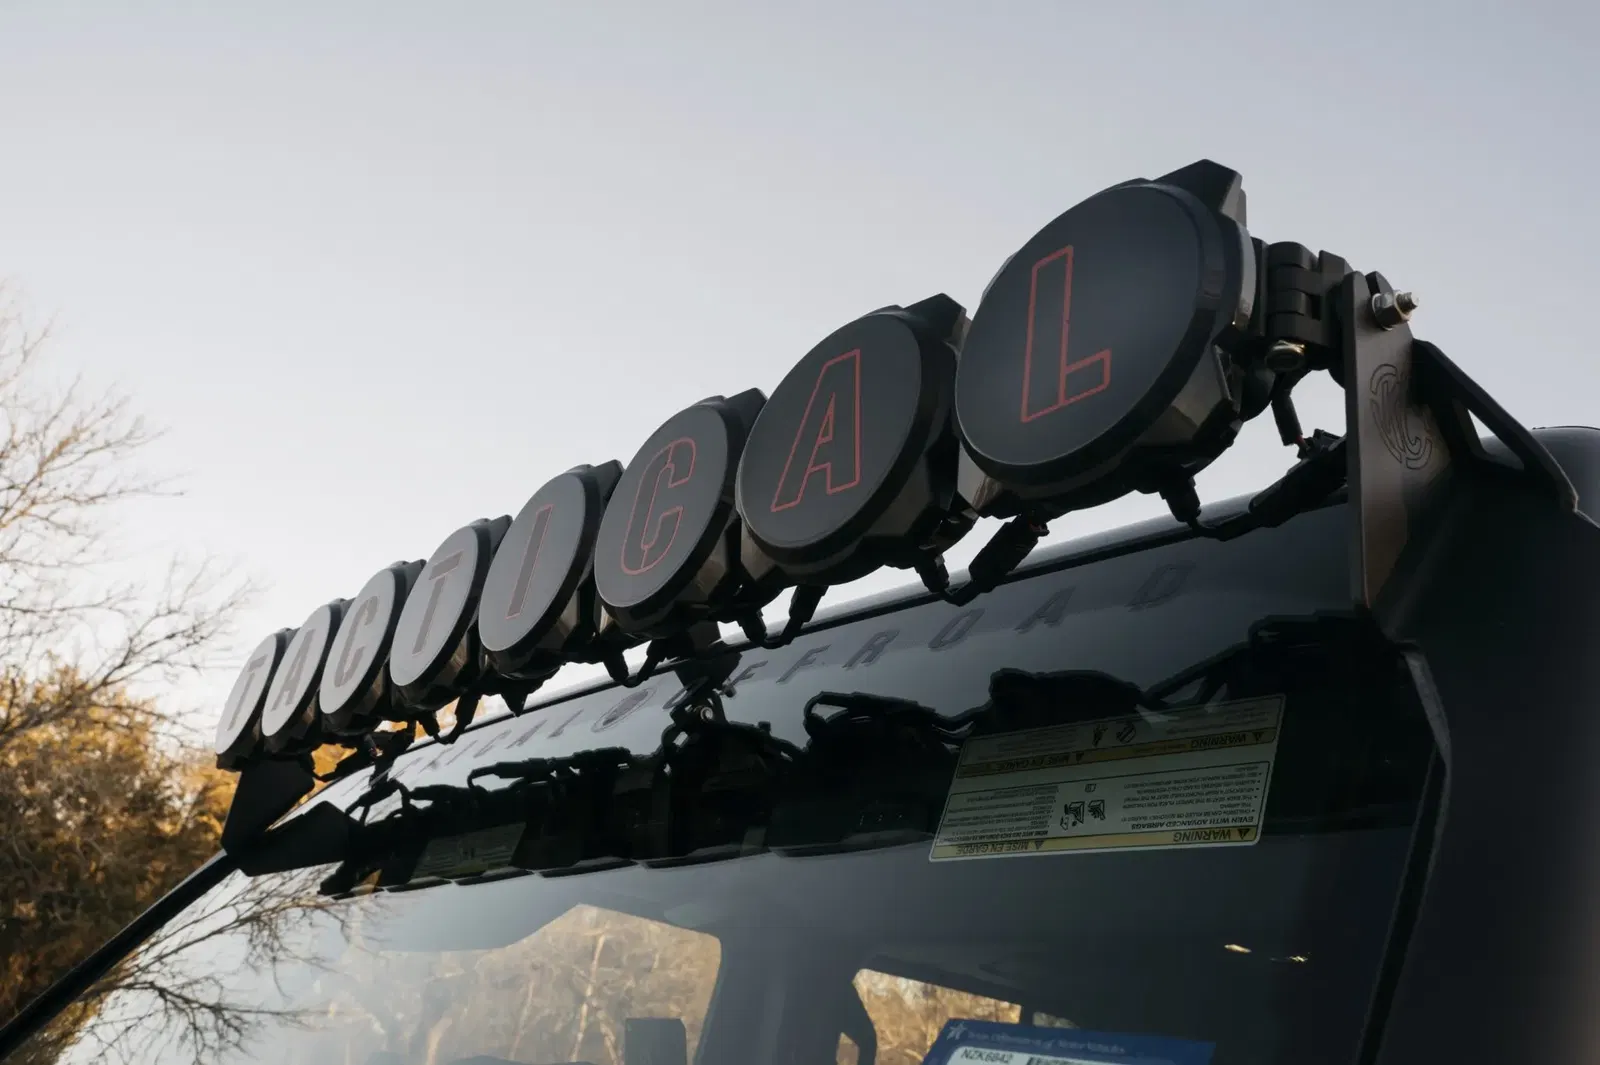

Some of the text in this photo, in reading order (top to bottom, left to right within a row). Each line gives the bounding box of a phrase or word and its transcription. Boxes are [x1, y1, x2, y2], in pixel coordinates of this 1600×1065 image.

[227, 245, 1112, 732] TACTICAL
[1190, 733, 1248, 749] WARNING
[1131, 821, 1164, 830] AIRBAGS
[1166, 819, 1209, 828] ADVANCED
[1232, 815, 1254, 823] EVEN
[1173, 829, 1231, 842] WARNING
[956, 841, 1029, 855] MISE EN GARDE
